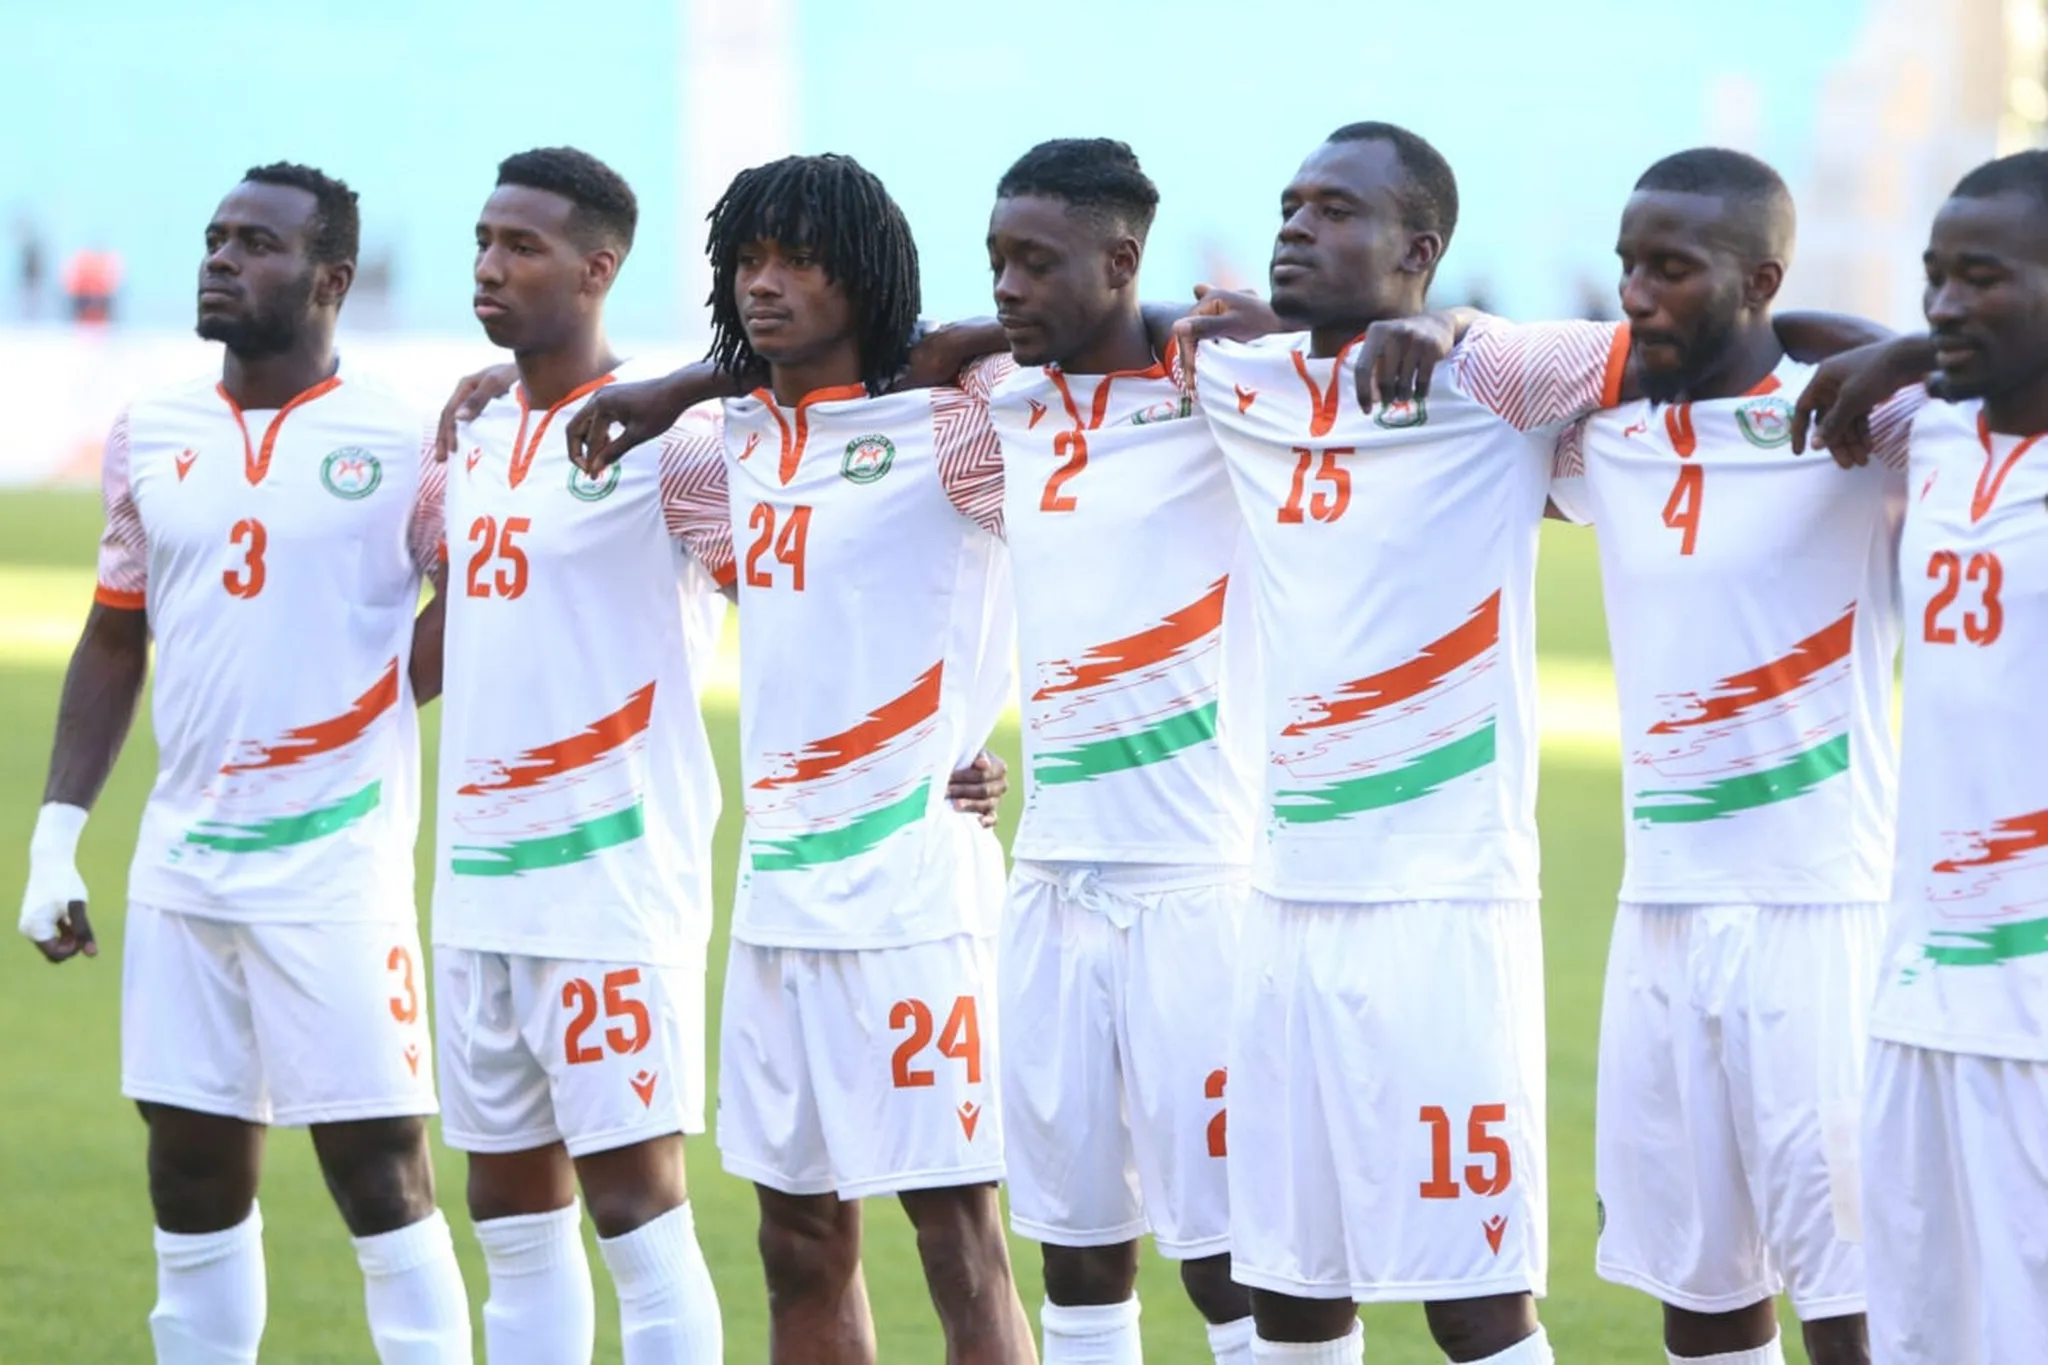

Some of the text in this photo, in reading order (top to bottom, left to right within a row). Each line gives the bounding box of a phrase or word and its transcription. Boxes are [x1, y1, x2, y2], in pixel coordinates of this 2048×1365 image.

[1039, 431, 1088, 512] 2
[1276, 446, 1356, 524] 15
[1662, 464, 1704, 555] 4
[222, 517, 268, 600] 3
[466, 515, 531, 600] 25
[745, 502, 812, 591] 24
[1923, 550, 2003, 647] 23
[386, 945, 418, 1024] 3
[562, 968, 652, 1066] 25
[888, 994, 981, 1088] 24
[1419, 1104, 1512, 1199] 15
